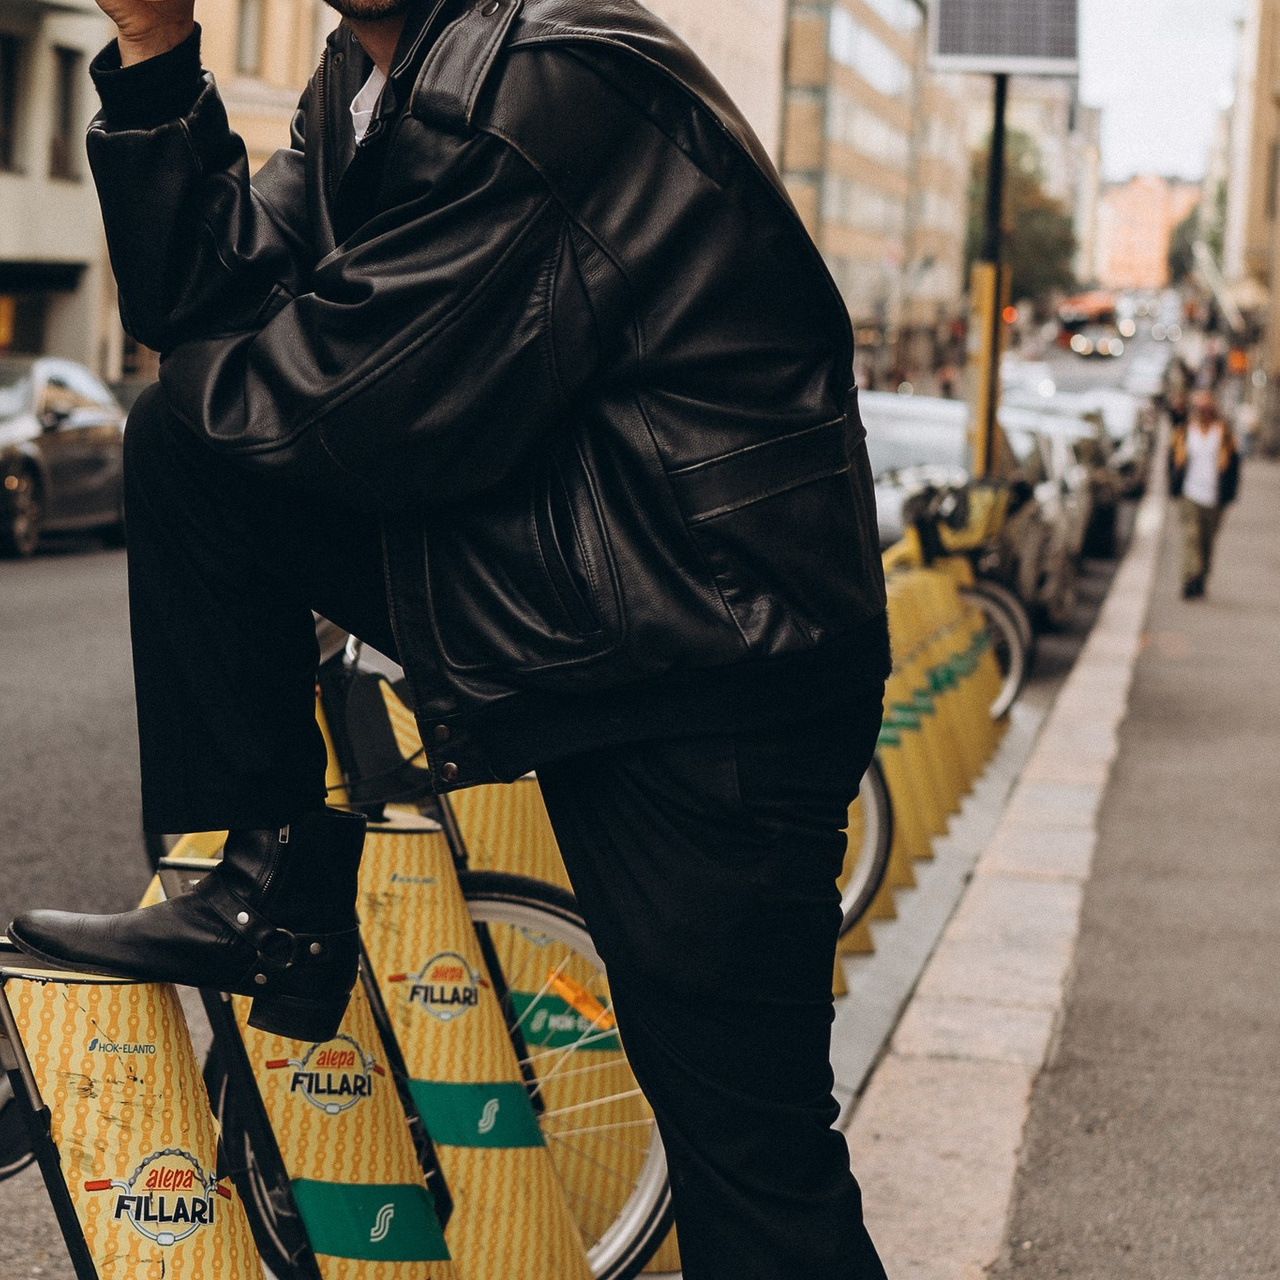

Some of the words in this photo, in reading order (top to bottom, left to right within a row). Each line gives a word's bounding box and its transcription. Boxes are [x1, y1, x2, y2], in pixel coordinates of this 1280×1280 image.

[409, 985, 479, 1006] FILLARI
[98, 1042, 156, 1055] HOK-ELANTO
[316, 1048, 356, 1070] alepa
[290, 1072, 372, 1096] FILLARI
[145, 1166, 195, 1192] alepa
[114, 1194, 215, 1224] FILLARI
